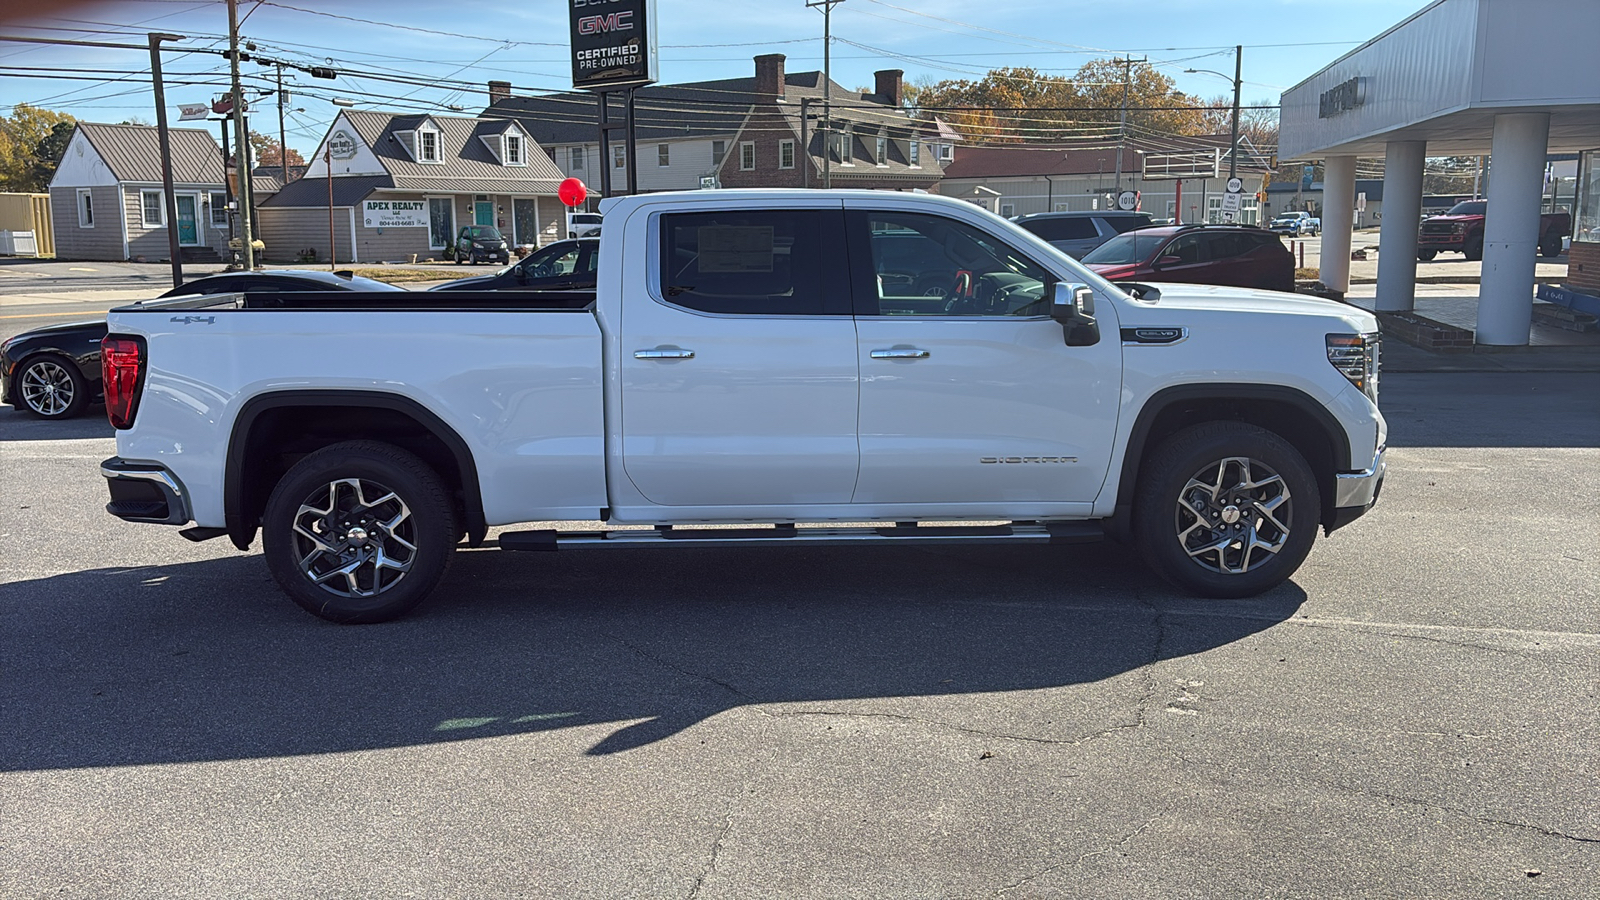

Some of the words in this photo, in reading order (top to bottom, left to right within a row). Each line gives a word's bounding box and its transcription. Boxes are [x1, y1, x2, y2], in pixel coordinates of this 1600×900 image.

[578, 11, 634, 35] GMC
[576, 44, 639, 60] CERTIFIED
[580, 55, 636, 69] PRE-OWNED
[367, 201, 390, 210] APEX
[392, 201, 424, 210] REALTY
[1120, 197, 1135, 205] 1010
[979, 456, 1078, 464] SIERRA
